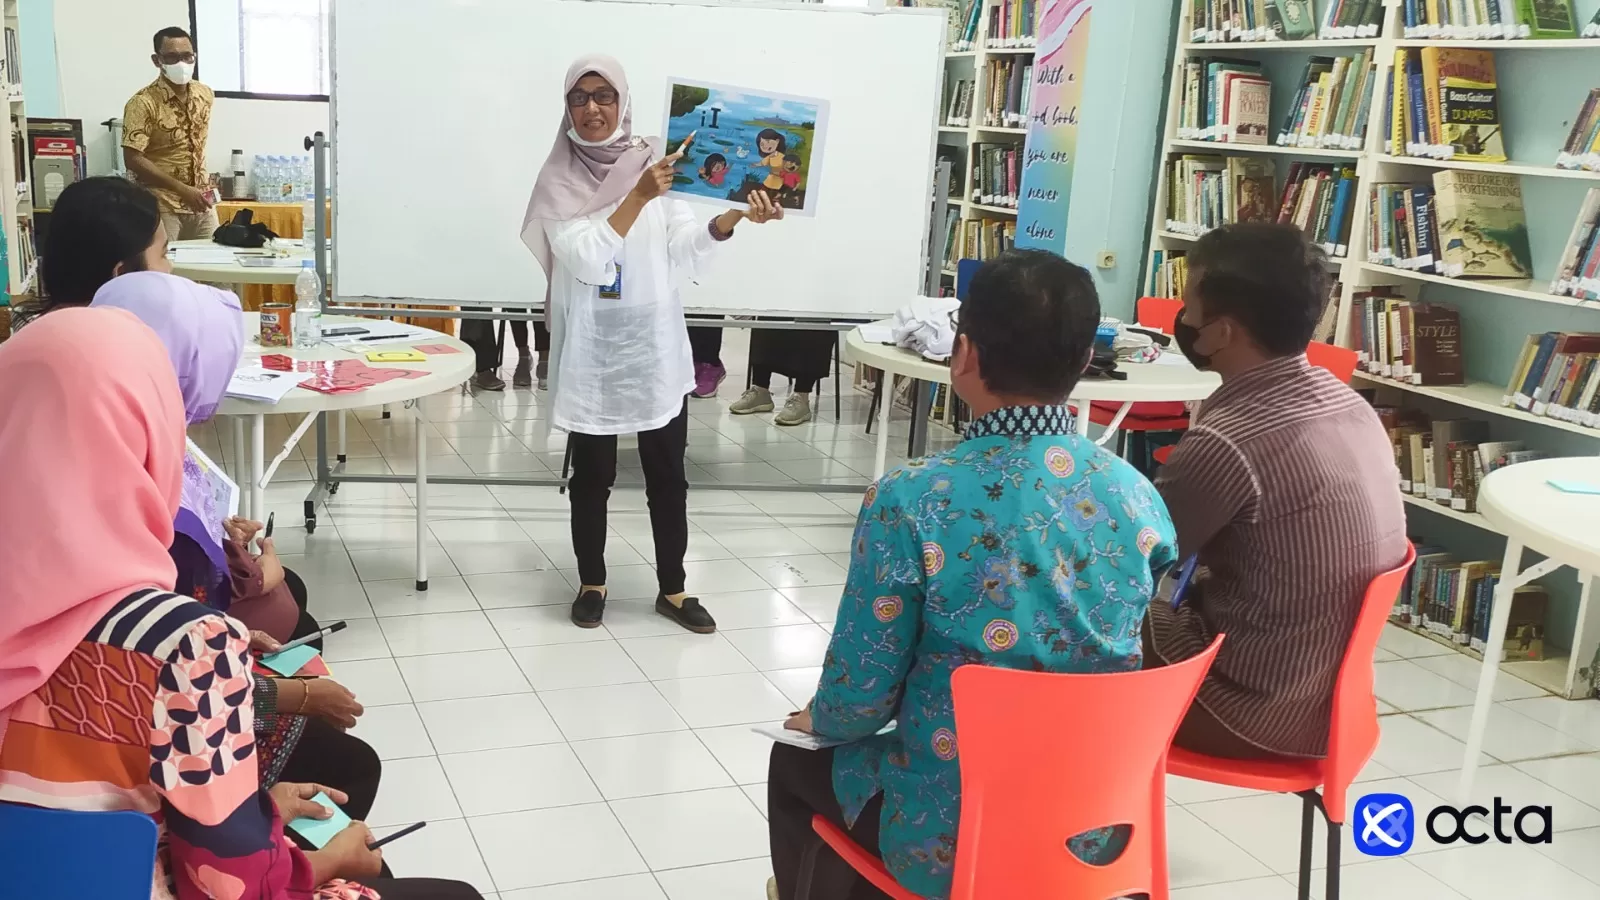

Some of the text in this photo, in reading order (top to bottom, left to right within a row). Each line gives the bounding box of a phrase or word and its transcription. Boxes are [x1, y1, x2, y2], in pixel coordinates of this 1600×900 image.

[1037, 65, 1077, 85] With a
[1450, 91, 1493, 102] Bass Guitar
[1239, 100, 1267, 114] POWER
[1031, 105, 1049, 125] od
[1309, 97, 1323, 132] FATIGUE
[1452, 109, 1494, 121] DUMMIES
[1026, 148, 1068, 168] you are
[1456, 173, 1516, 187] THE LORE OF
[1028, 187, 1059, 201] never
[1453, 184, 1521, 198] SPORTFISHING
[1026, 220, 1055, 238] alone
[1416, 204, 1428, 249] Fishing
[260, 313, 276, 321] OX'S
[1416, 325, 1457, 338] STYLE
